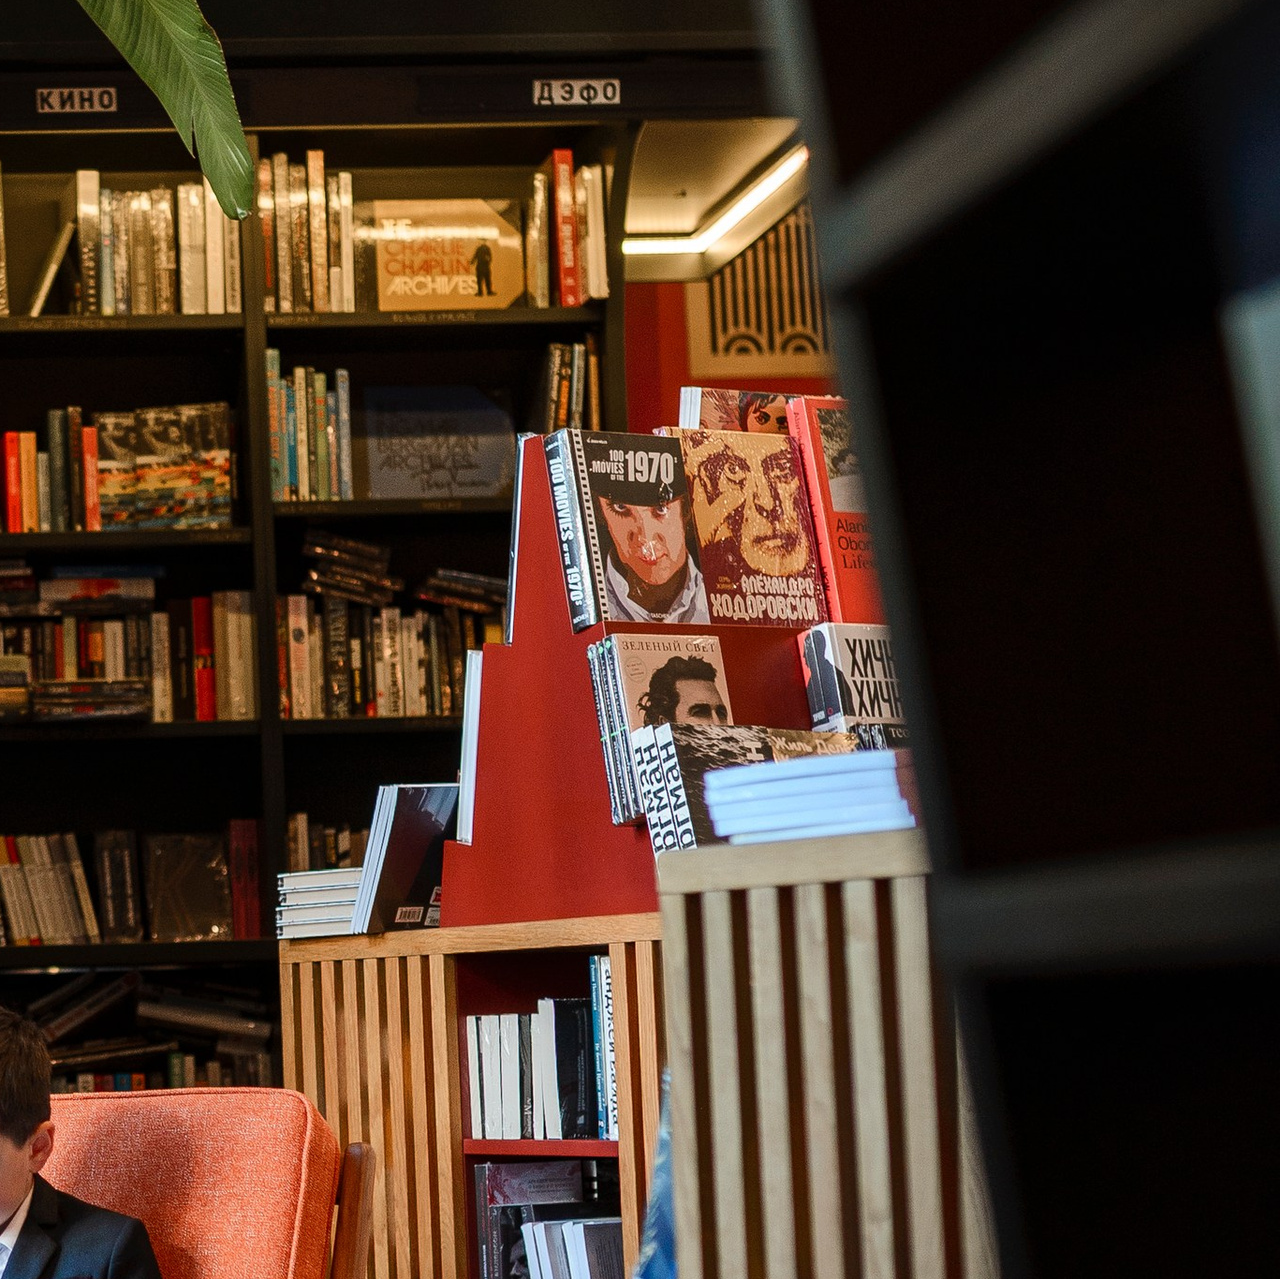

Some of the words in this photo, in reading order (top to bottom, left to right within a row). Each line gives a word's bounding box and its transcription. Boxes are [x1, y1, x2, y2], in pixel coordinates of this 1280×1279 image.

[39, 89, 114, 110] КИНО
[537, 81, 617, 106] ДЭФО
[384, 240, 464, 256] CHARLIE
[384, 258, 471, 275] CHAPLIN
[387, 275, 478, 296] ARCHIVES
[609, 449, 625, 462] 100
[548, 456, 565, 483] 100
[592, 460, 625, 475] MOVIES
[553, 484, 575, 542] MOVIES
[740, 574, 815, 597] АЛЕХАНДРО
[710, 593, 819, 621] ХОДОРОВСКИ
[622, 640, 682, 652] ЗЕЛЕНЫЙ
[685, 642, 716, 653] СВЕТ
[771, 735, 813, 752] Жиль
[643, 742, 676, 851] ргман
[659, 740, 694, 849] ргман
